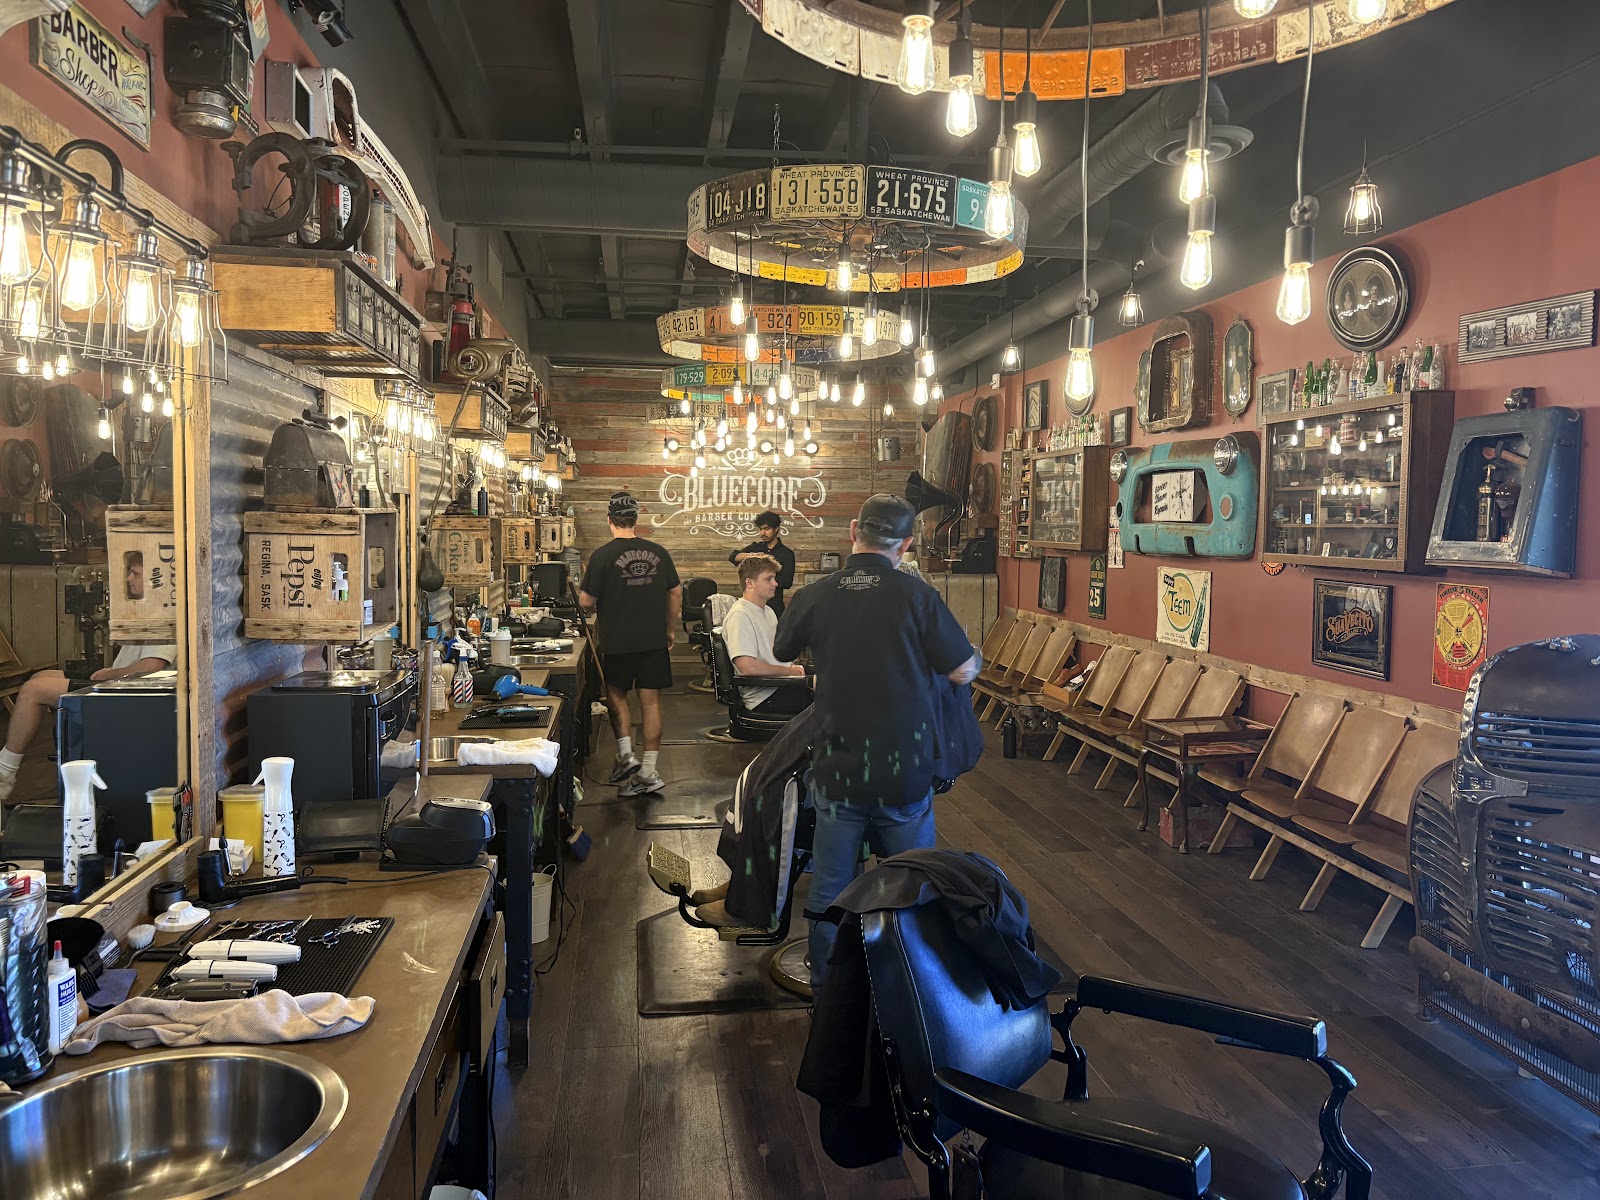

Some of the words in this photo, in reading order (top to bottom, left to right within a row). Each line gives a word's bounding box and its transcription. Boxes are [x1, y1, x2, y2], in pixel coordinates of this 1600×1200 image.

[51, 10, 119, 89] BARBER
[59, 47, 100, 96] Shop
[778, 171, 807, 180] WHEAT
[810, 169, 857, 178] PROVINCE
[875, 171, 908, 182] WHEAT
[911, 174, 950, 188] PROVINCE
[774, 205, 845, 215] SASKATCHEWAN
[846, 205, 859, 213] 53
[870, 206, 882, 214] 52
[884, 207, 951, 222] SASKATCHEWAN
[683, 474, 802, 513] BLUECORE
[695, 512, 733, 523] BARBER
[738, 512, 757, 521] COM
[260, 540, 271, 579] REGINA,
[449, 532, 463, 572] Coke
[615, 549, 661, 569] BLUECORE
[281, 543, 315, 609] Pepsi
[311, 568, 324, 591] enjoy
[260, 583, 271, 612] SASK.
[1089, 588, 1101, 608] 25
[1465, 587, 1484, 604] TELLER
